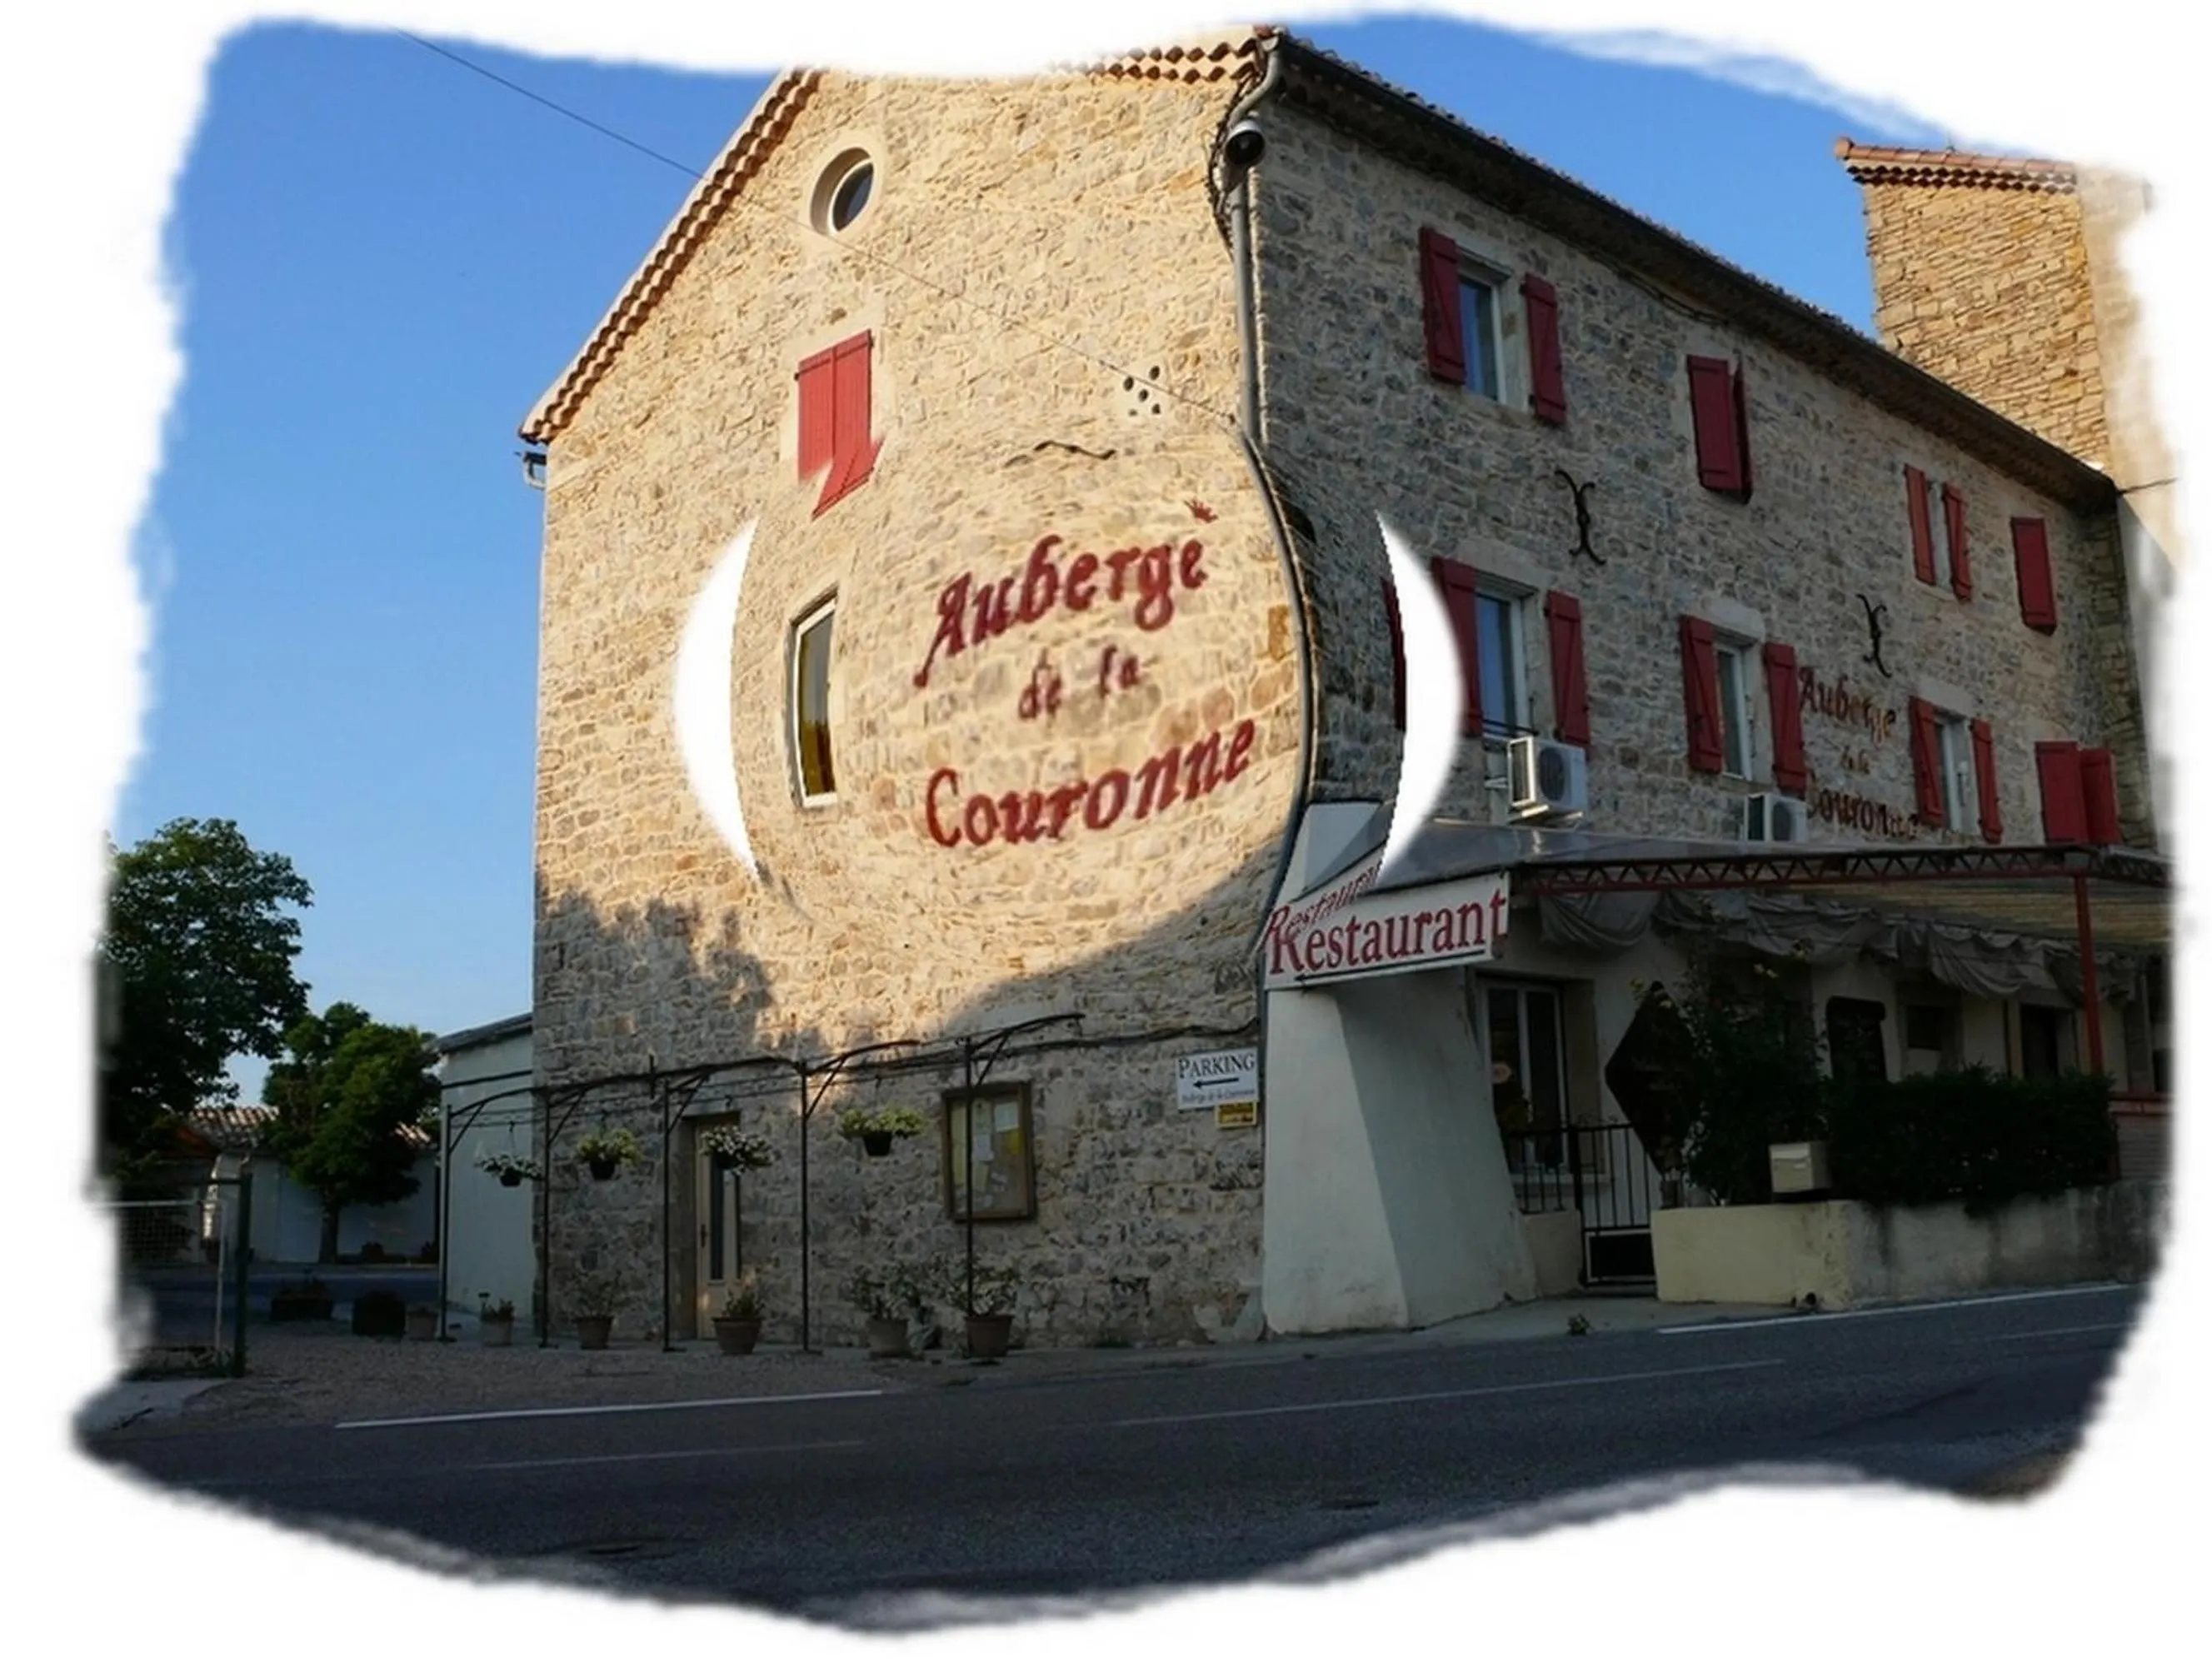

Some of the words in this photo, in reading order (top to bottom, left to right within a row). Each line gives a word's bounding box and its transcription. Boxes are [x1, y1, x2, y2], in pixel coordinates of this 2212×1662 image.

[914, 534, 1208, 688] Auberge
[1017, 647, 1063, 721] de
[1099, 644, 1141, 700] la
[926, 718, 1255, 847] Couronne
[1268, 886, 1508, 976] Restaurant
[1178, 1053, 1255, 1079] PARKING
